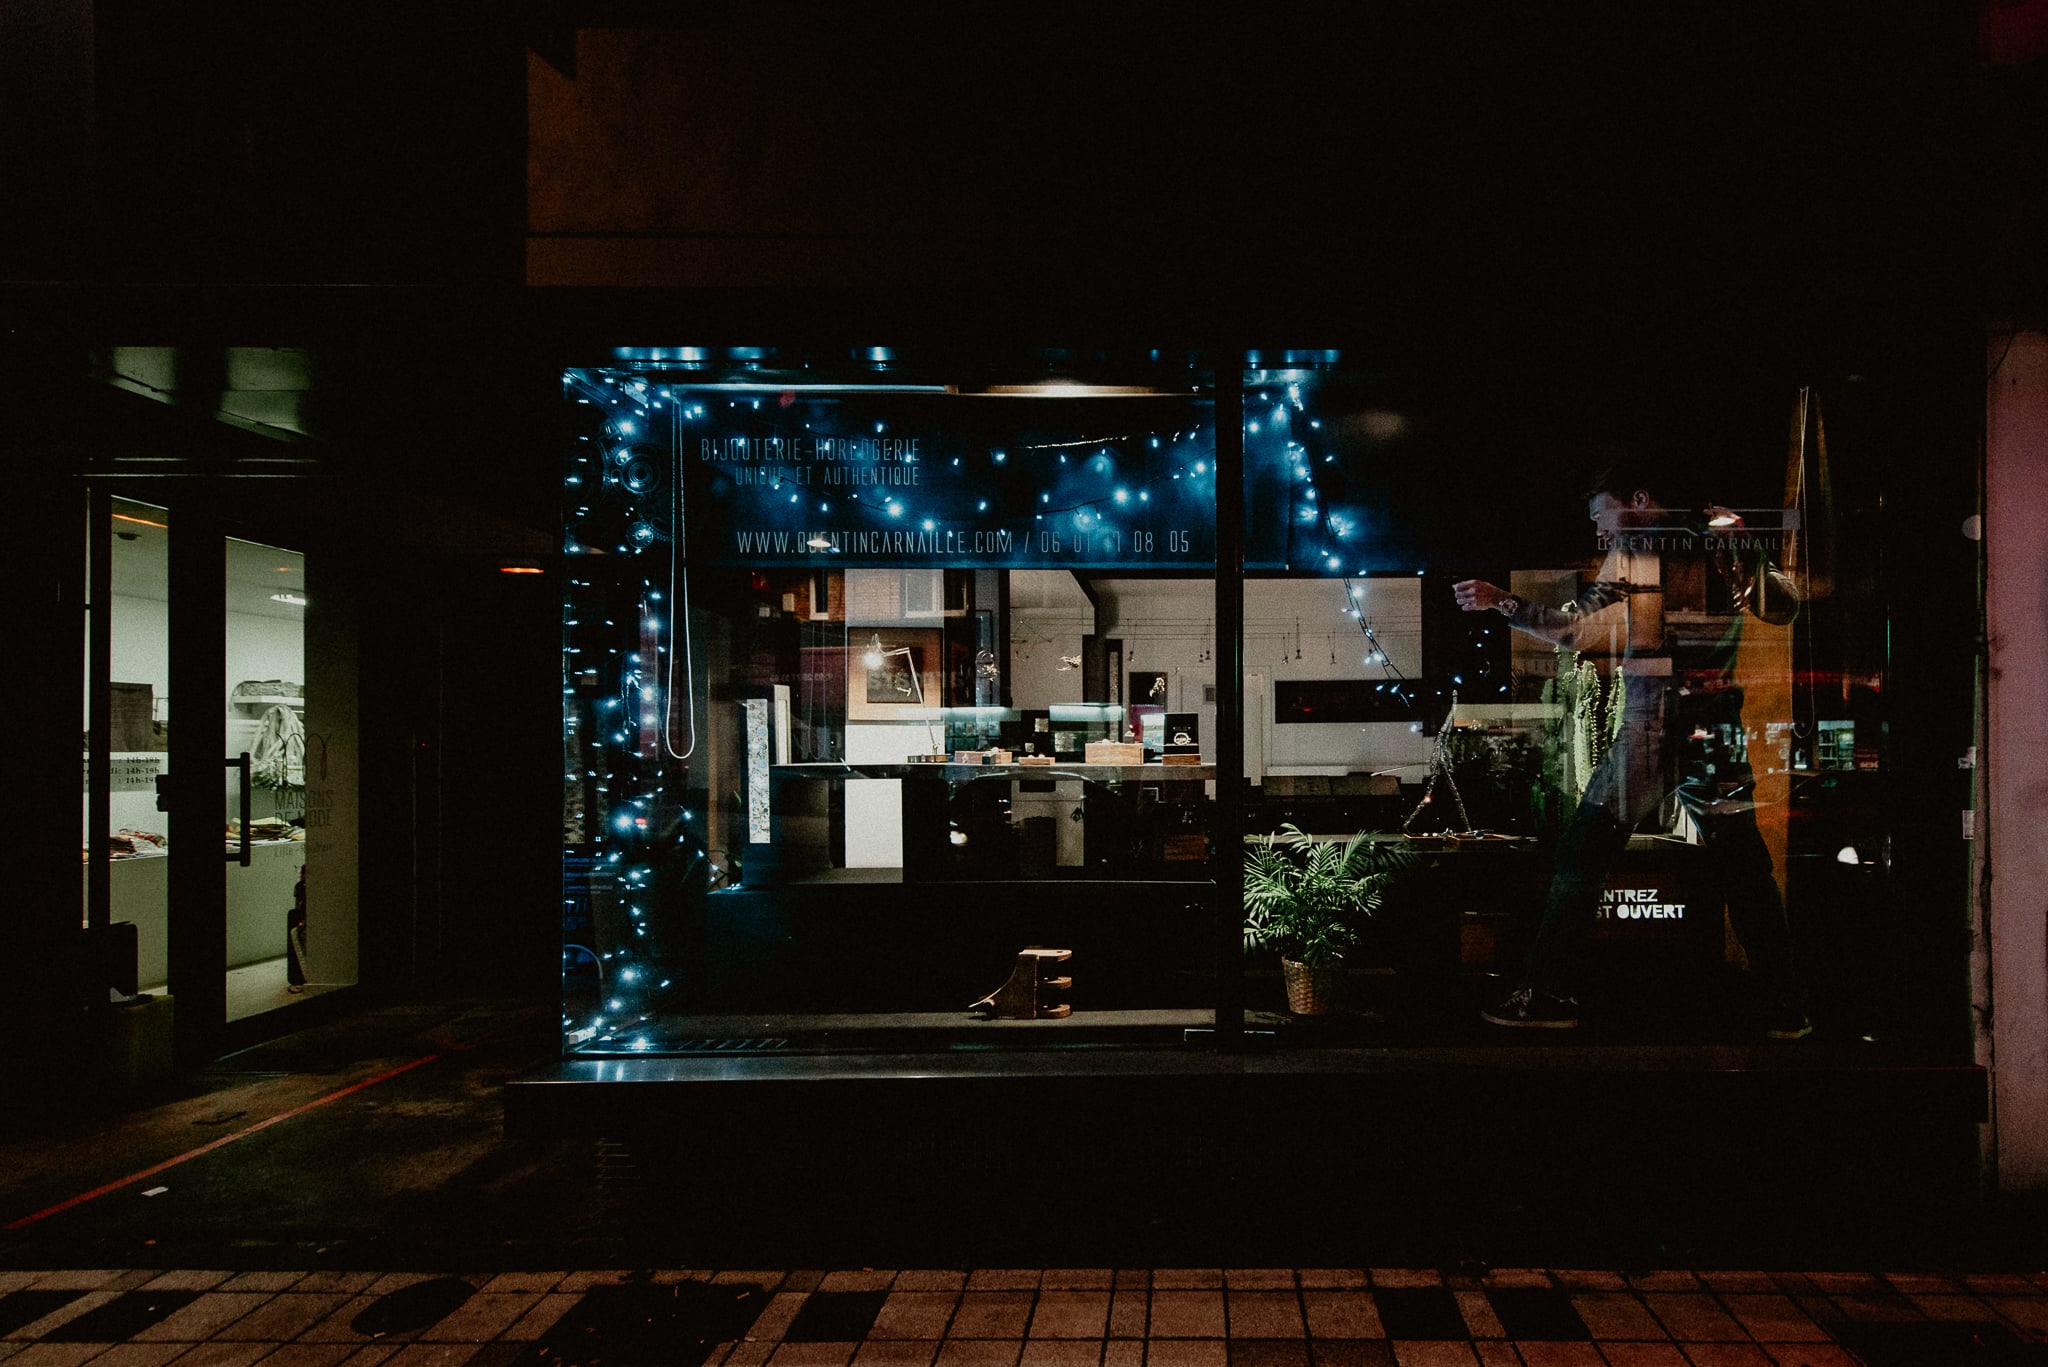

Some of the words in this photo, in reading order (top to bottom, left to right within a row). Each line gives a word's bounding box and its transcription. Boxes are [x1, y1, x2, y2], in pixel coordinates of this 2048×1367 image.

[796, 466, 812, 485] ET
[823, 465, 920, 486] AUTHENTIQUE
[1134, 531, 1154, 553] 08
[1170, 531, 1189, 553] 05
[1600, 889, 1659, 903] NTREZ
[1616, 904, 1686, 920] OUVERT
